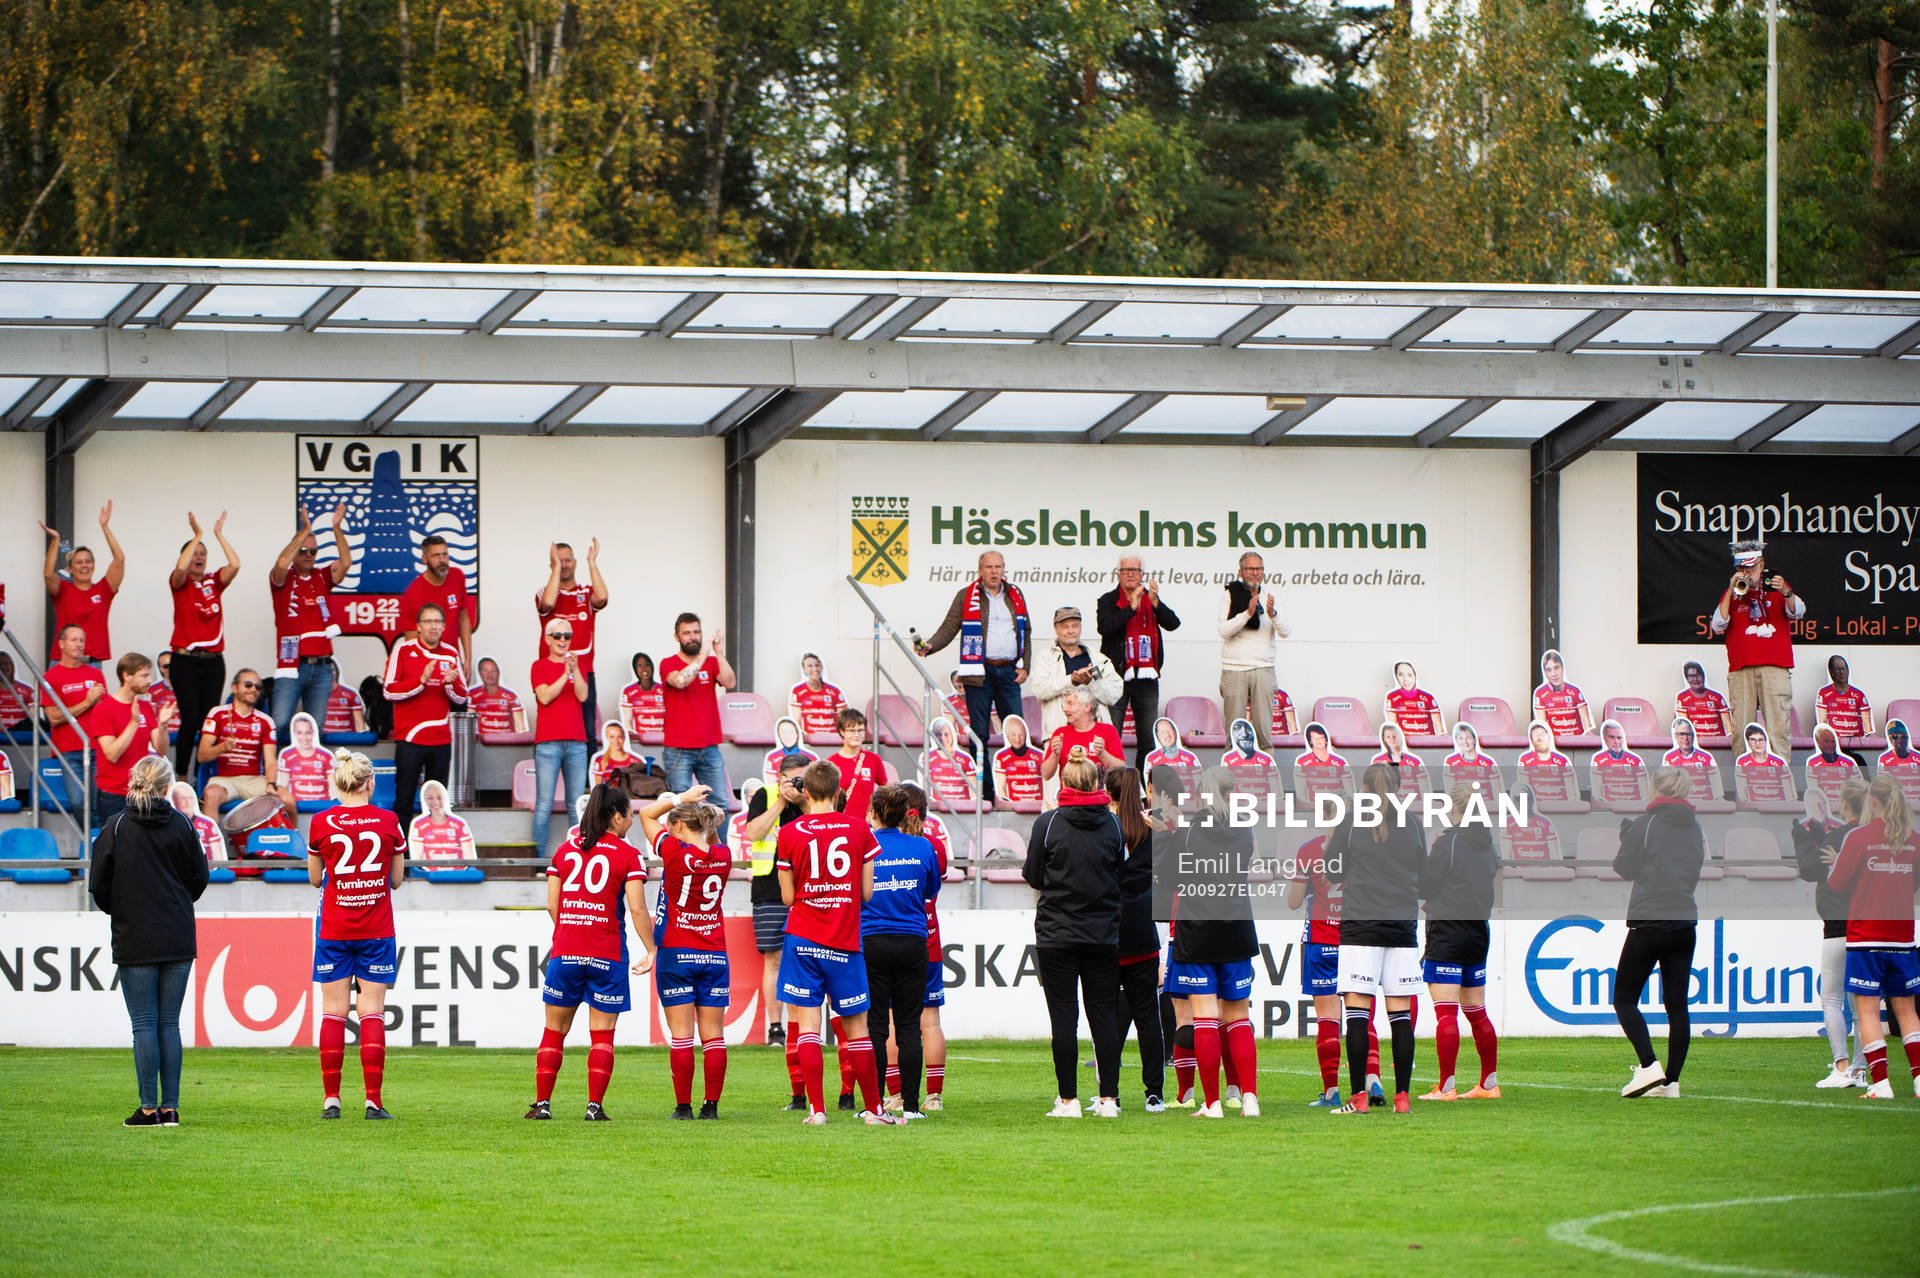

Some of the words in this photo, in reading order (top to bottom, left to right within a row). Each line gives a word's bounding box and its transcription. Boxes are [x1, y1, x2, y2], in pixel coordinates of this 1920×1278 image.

[931, 506, 1217, 547] Hässleholms
[1228, 511, 1426, 548] kommun
[1655, 490, 1920, 547] Snapphaneby
[929, 565, 962, 583] Här
[1013, 567, 1106, 583] människor
[1168, 568, 1208, 586] leva,
[1291, 570, 1348, 586] arbeta
[1352, 570, 1384, 585] och
[1387, 570, 1425, 585] lära.
[1844, 550, 1920, 604] Spa
[344, 601, 375, 624] 19
[376, 599, 399, 612] 22
[1836, 617, 1886, 636] Lokal
[330, 831, 383, 875] 22
[563, 852, 610, 894] 20
[808, 836, 851, 879] 16
[676, 874, 722, 912] 19
[0, 945, 122, 992] NSK
